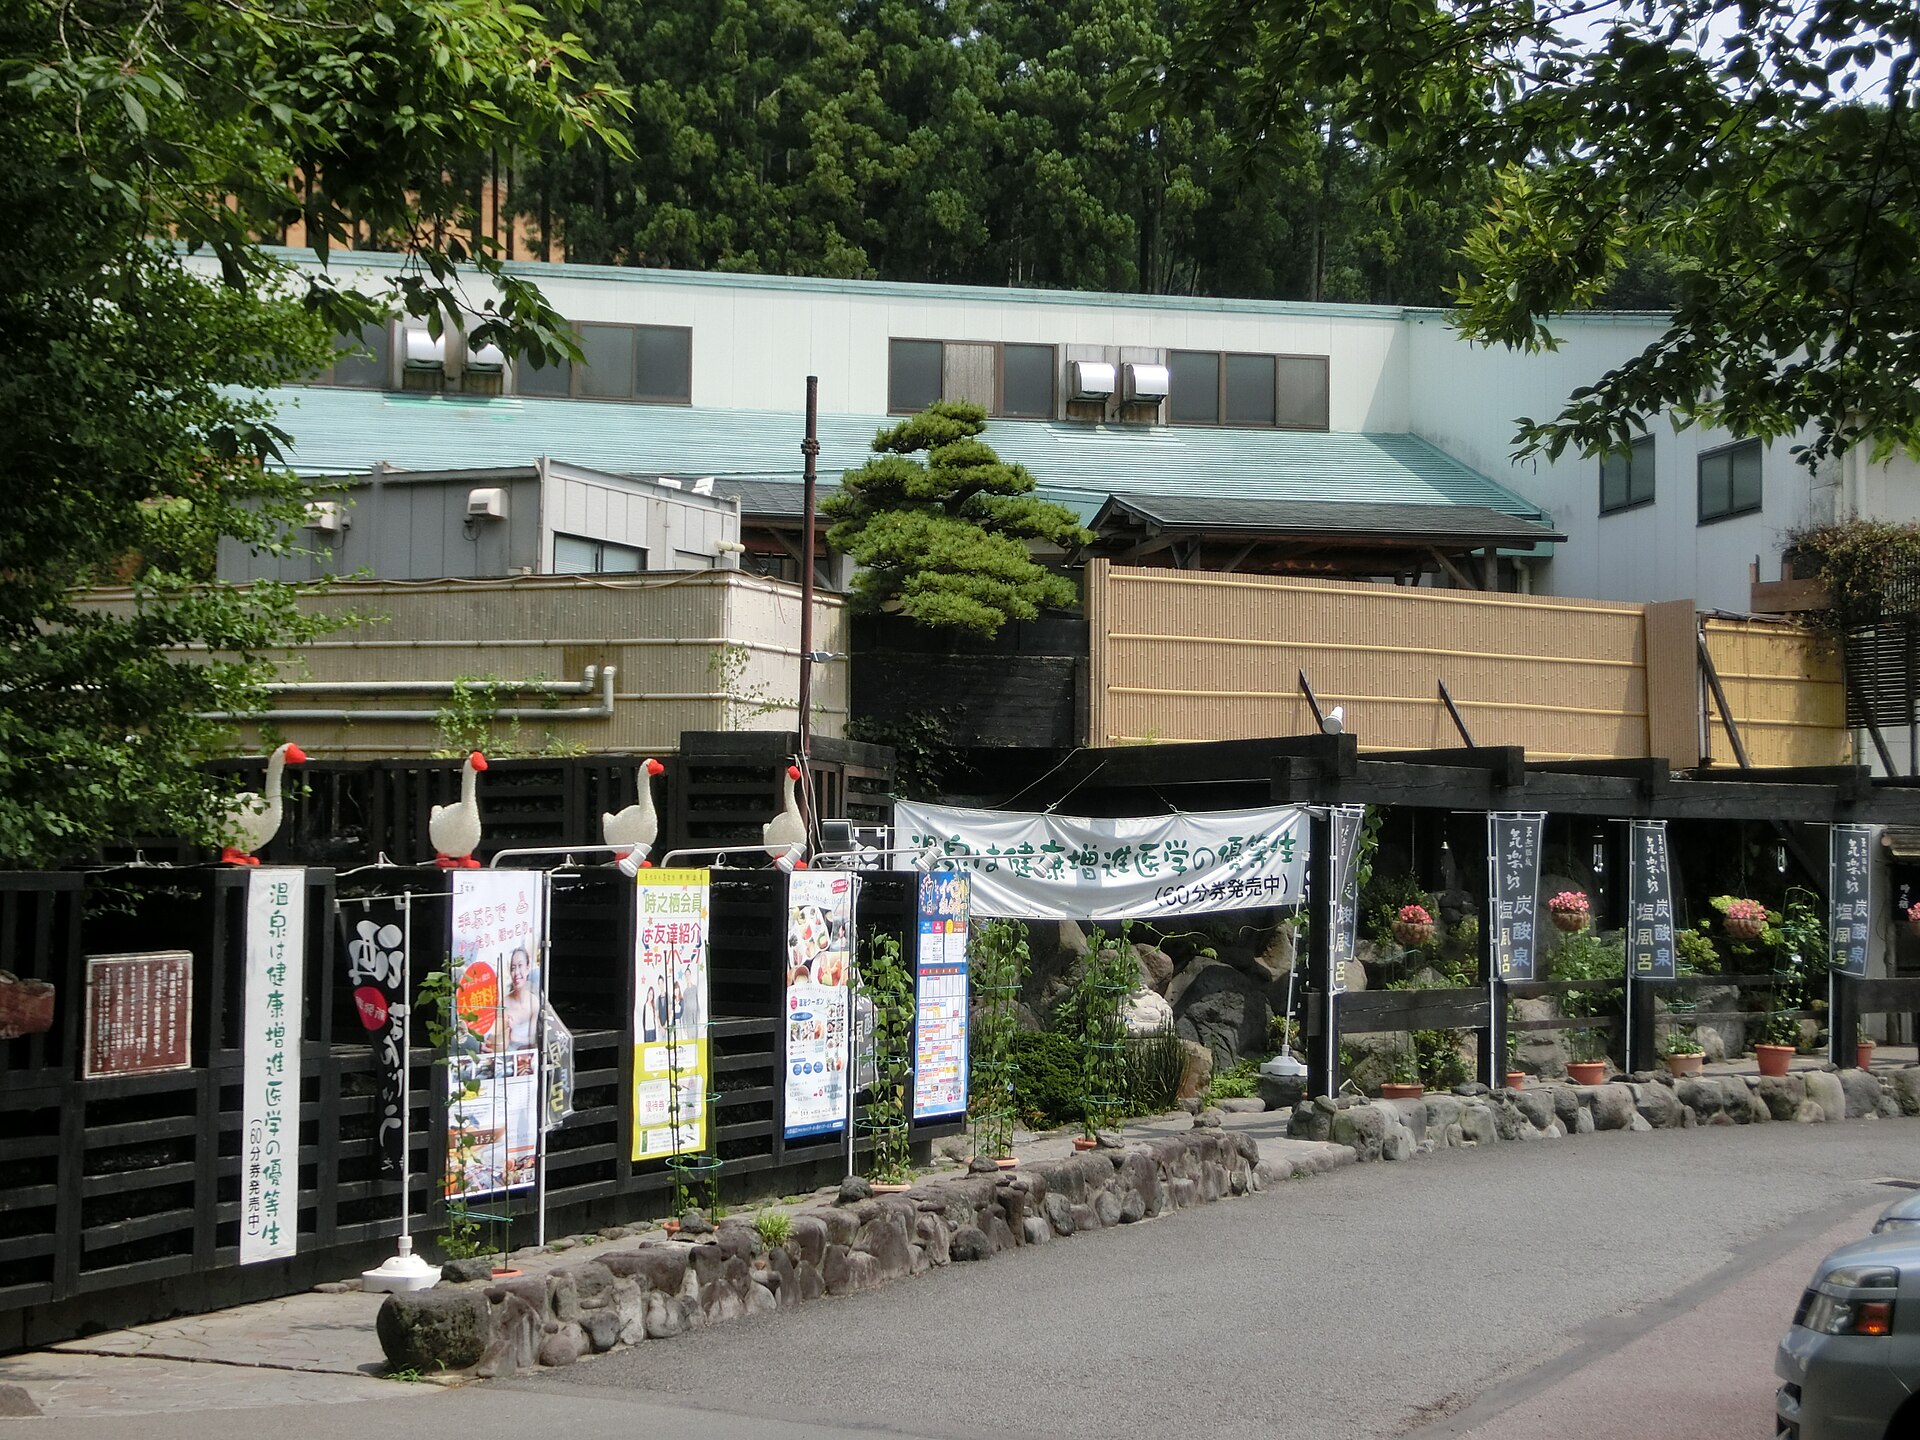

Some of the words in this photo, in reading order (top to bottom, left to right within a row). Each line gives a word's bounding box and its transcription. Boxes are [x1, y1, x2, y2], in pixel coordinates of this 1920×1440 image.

[644, 892, 701, 914] 時之栖会員
[644, 923, 702, 944] お友達紹介
[1500, 900, 1514, 973] 塩風呂
[1512, 895, 1533, 967] 炭酸泉
[1635, 903, 1655, 971] 塩風呂
[1654, 899, 1672, 967] 炭酸泉
[1835, 903, 1853, 965] 塩風呂
[1850, 899, 1868, 964] 炭酸泉
[261, 882, 289, 1246] 温泉は健康増進医学の優等生
[247, 1118, 263, 1237] (60分券発売中)
